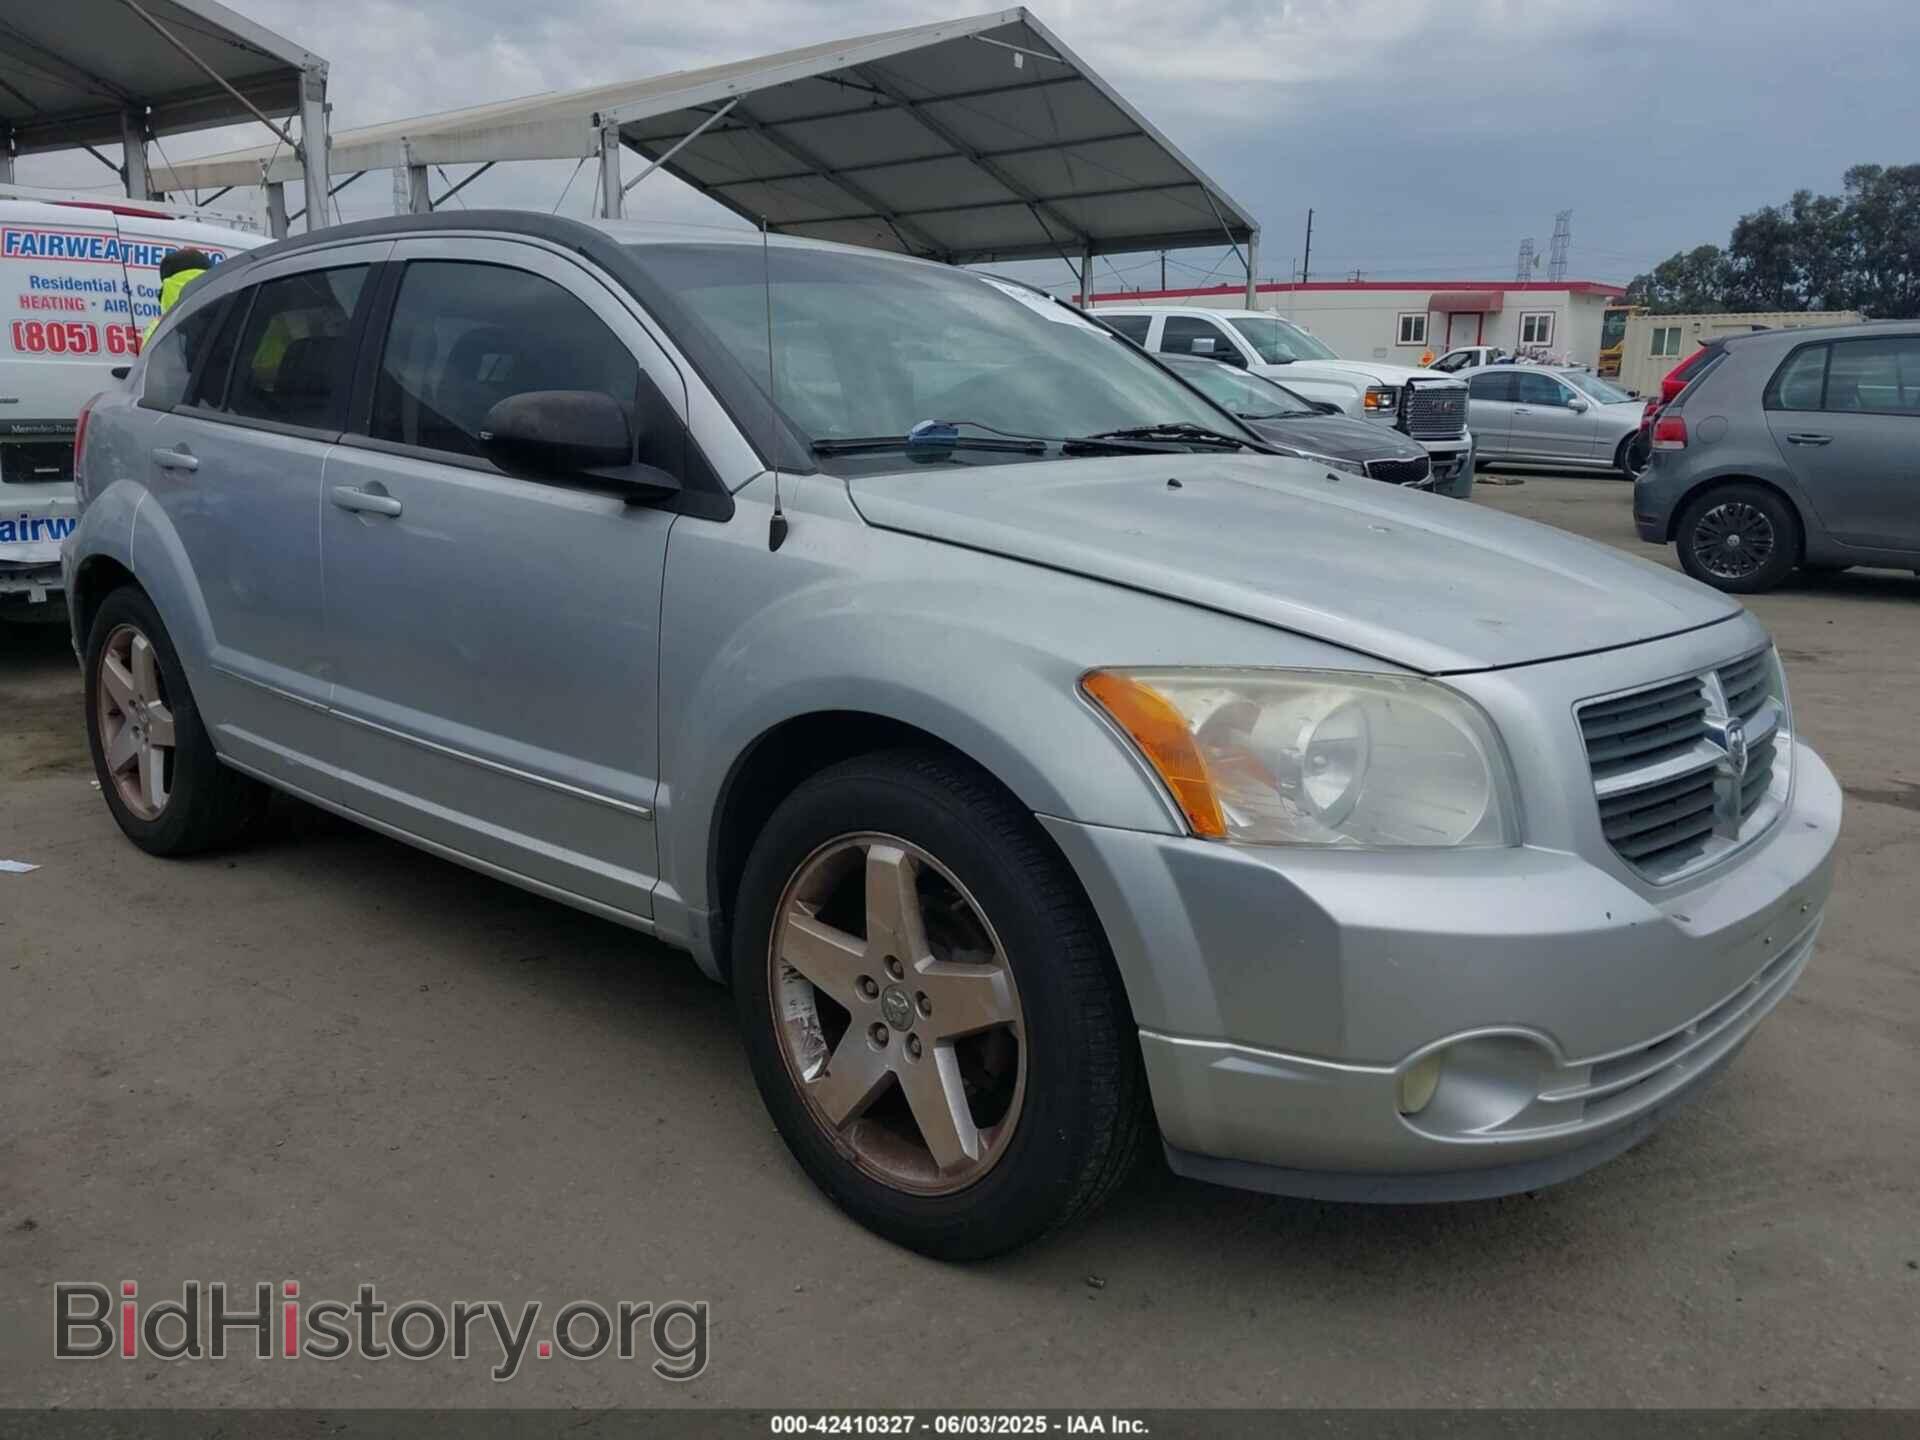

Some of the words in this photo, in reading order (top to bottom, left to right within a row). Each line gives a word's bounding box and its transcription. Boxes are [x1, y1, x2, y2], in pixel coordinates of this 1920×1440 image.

[30, 275, 116, 293] Residential
[122, 281, 132, 296] &
[20, 295, 85, 311] HEATING
[104, 299, 129, 313] AIR
[11, 321, 99, 354] (805)
